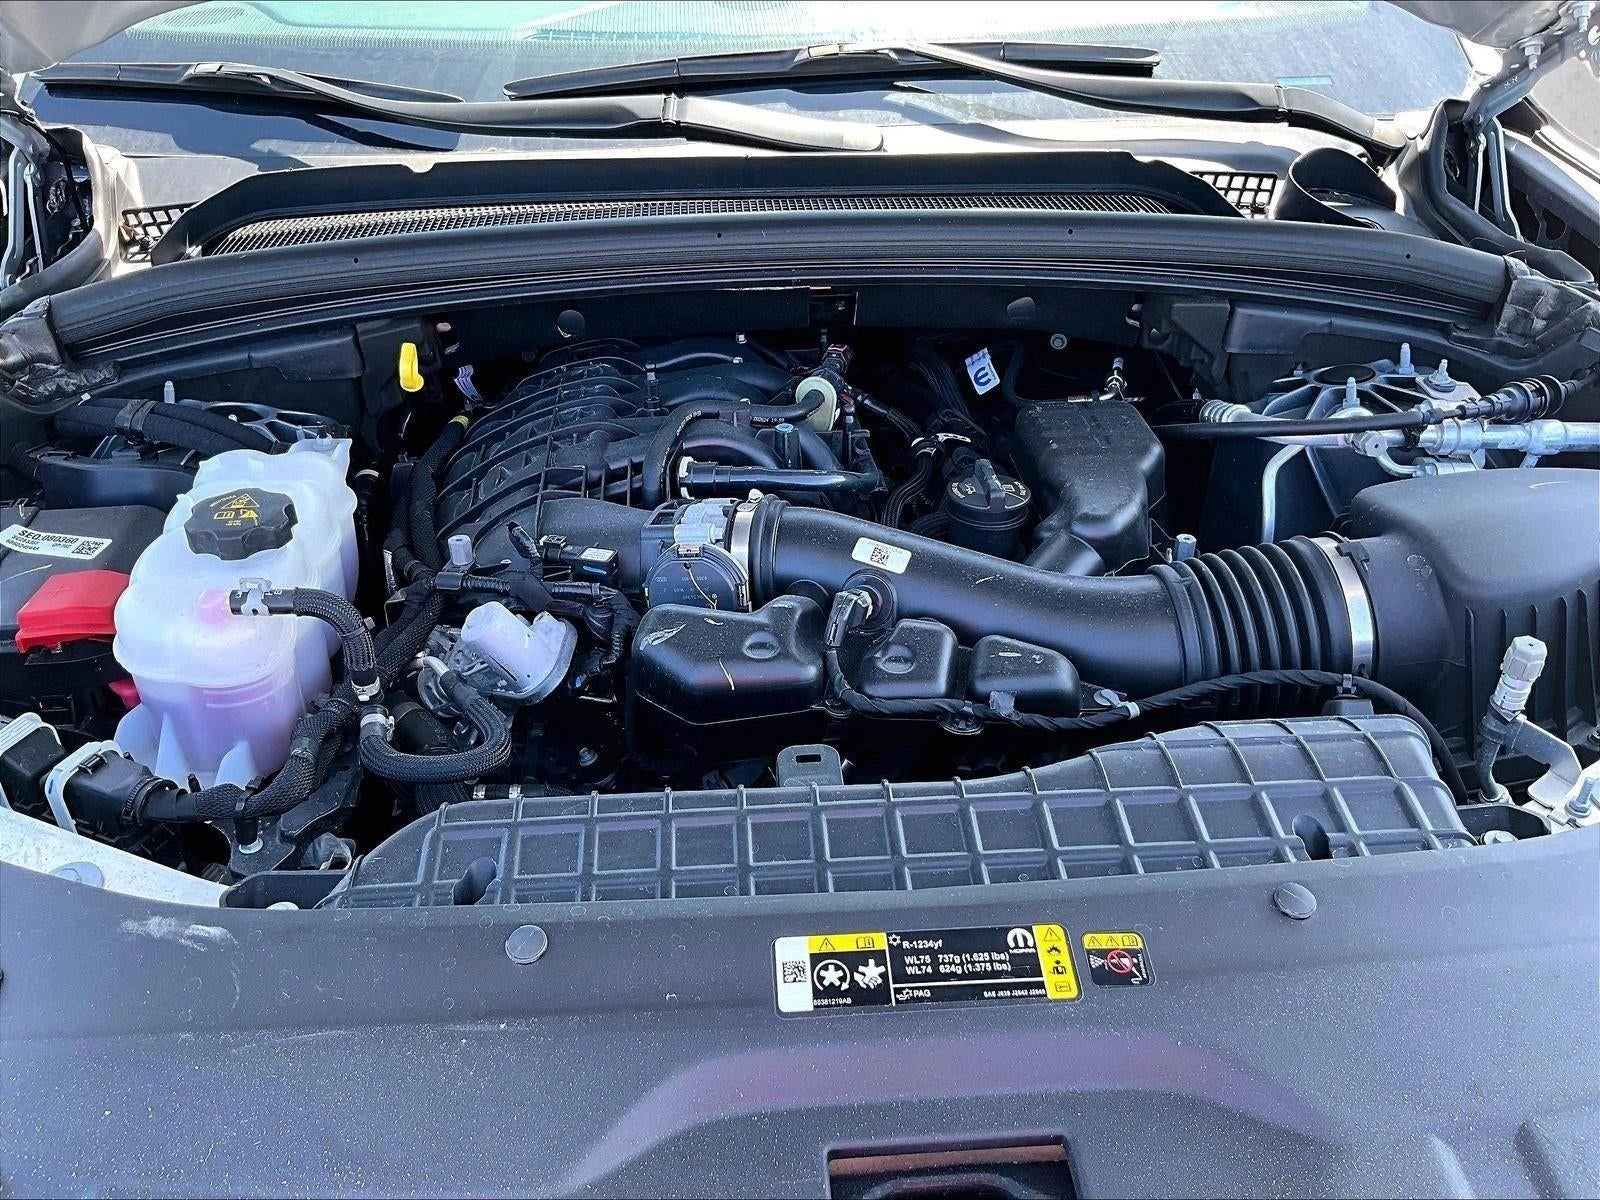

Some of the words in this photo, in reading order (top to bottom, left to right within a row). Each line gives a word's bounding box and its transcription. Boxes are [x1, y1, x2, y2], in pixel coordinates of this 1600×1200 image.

[902, 939, 943, 950] R-1234yf
[904, 955, 931, 965] WL75
[937, 954, 961, 964] 737g
[991, 951, 1010, 962] lbs)
[905, 965, 933, 975] WL74
[938, 964, 963, 974] 624g
[993, 962, 1012, 972] lbs)
[913, 989, 931, 998] PAG
